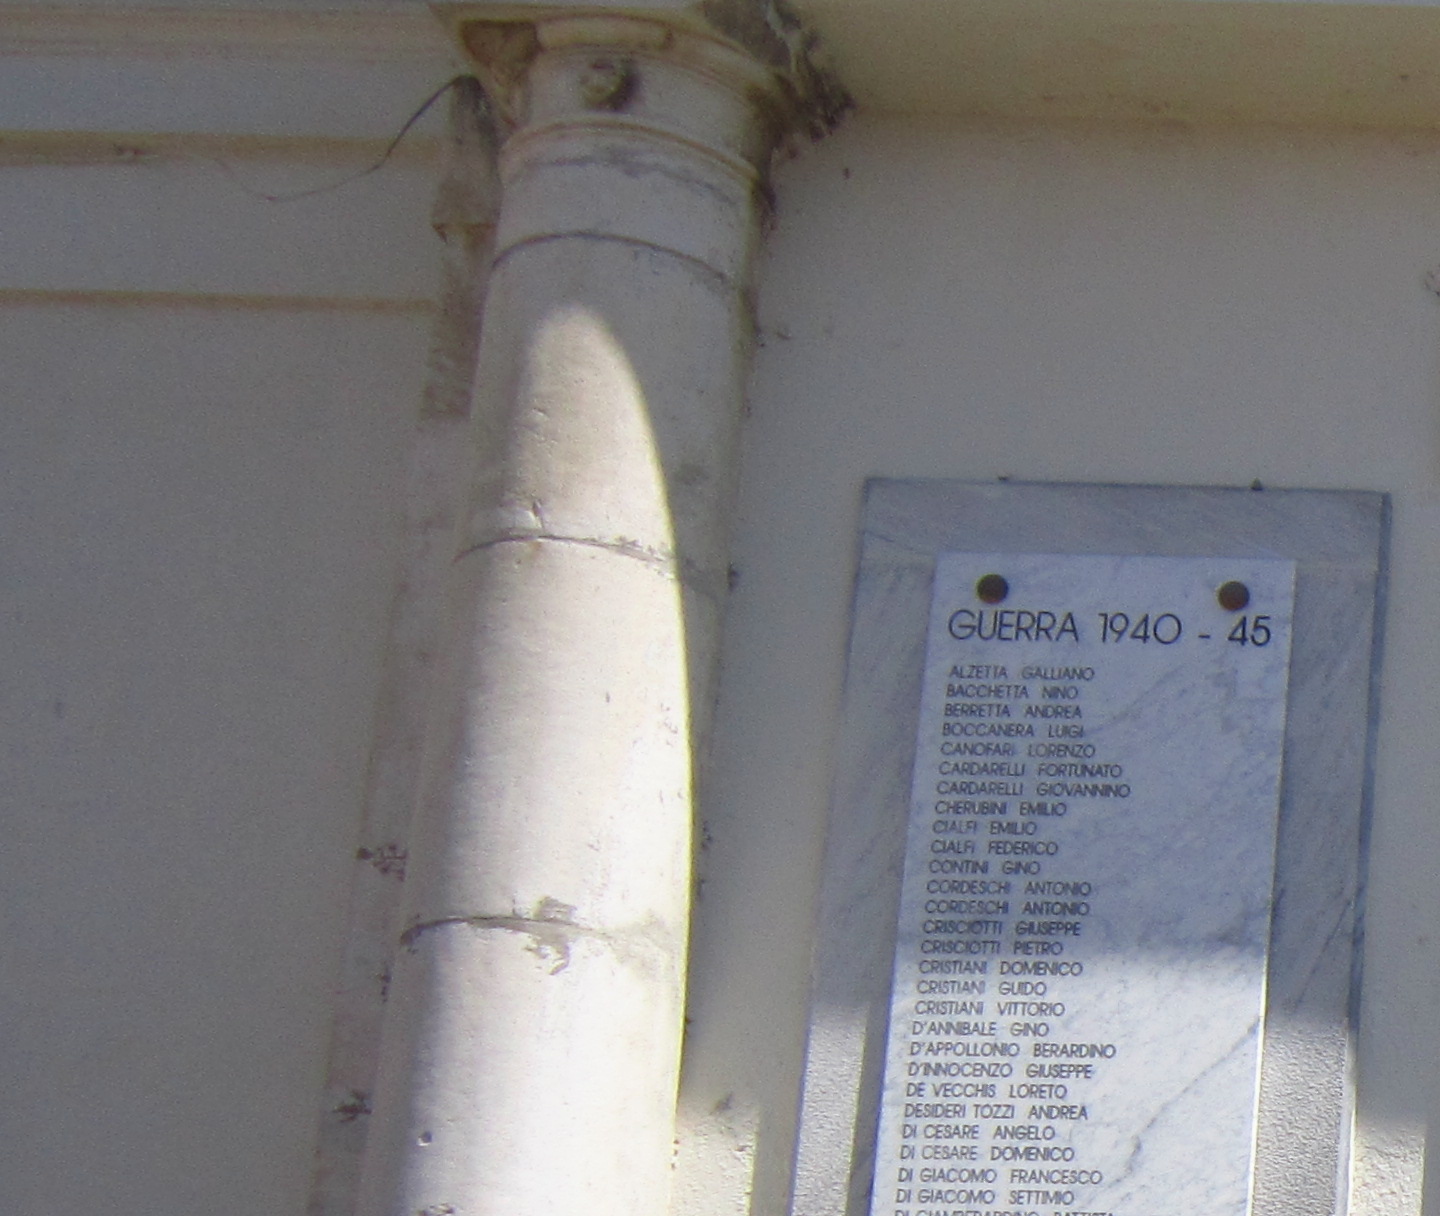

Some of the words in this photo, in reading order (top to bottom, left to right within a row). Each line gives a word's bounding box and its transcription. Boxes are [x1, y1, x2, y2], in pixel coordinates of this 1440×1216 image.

[948, 610, 1079, 642] GUERRA
[1100, 612, 1182, 644] 1940
[1228, 615, 1271, 646] 45
[950, 666, 1008, 680] ALZETTA
[1021, 667, 1094, 681] GALLIANO
[946, 685, 1028, 698] BACCHETTA
[1042, 685, 1078, 699] NINO
[945, 704, 1010, 718] BERRETTA
[1024, 705, 1081, 719] ANDREA
[943, 723, 1034, 737] BOCCANERA
[1048, 724, 1084, 738] LUIGI
[925, 900, 1008, 915] CORDESCHI
[1022, 901, 1089, 916] ANTONIO
[923, 920, 1002, 935] CRISCIOTTI
[1015, 921, 1081, 935] GIUSEPPE
[915, 1001, 984, 1016] CRISTIANI
[998, 1002, 1065, 1016] VITTORIO
[912, 1021, 996, 1036] D'ANNIBALE
[1010, 1022, 1049, 1037] GINO
[910, 1042, 1019, 1057] D'APPOLLONIO
[1034, 1043, 1115, 1058] BERARDINO
[906, 1083, 925, 1097] DE
[934, 1084, 995, 1098] VECCHIS
[1009, 1084, 1067, 1099] LORETO
